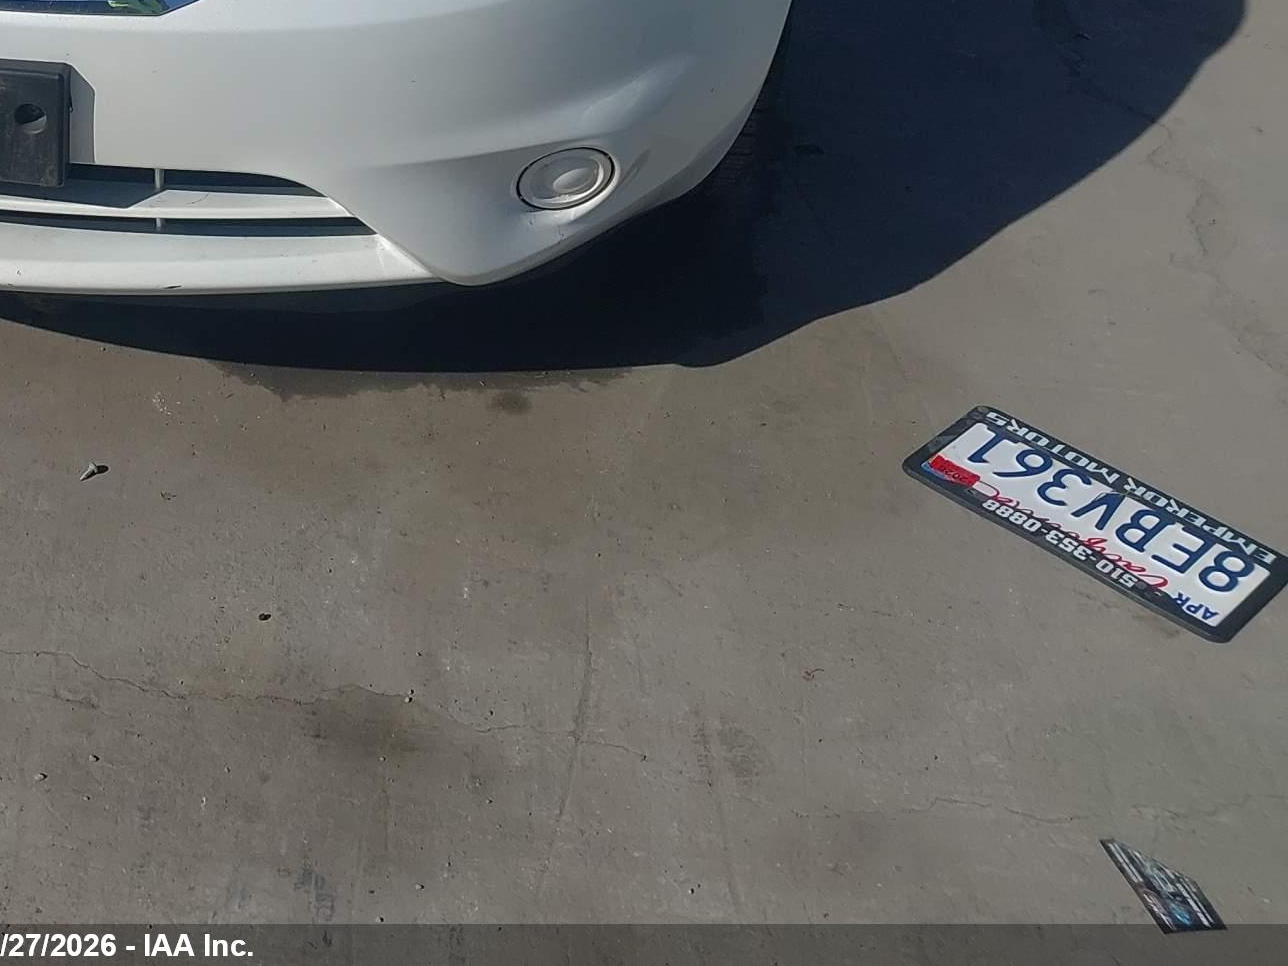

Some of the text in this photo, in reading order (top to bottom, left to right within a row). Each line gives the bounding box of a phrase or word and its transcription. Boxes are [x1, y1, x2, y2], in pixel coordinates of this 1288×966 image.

[967, 425, 1255, 593] 8EBV361
[982, 499, 1139, 588] 510-353-0888
[985, 411, 1278, 565] EMPEROR MOTORS
[1175, 591, 1219, 621] APR
